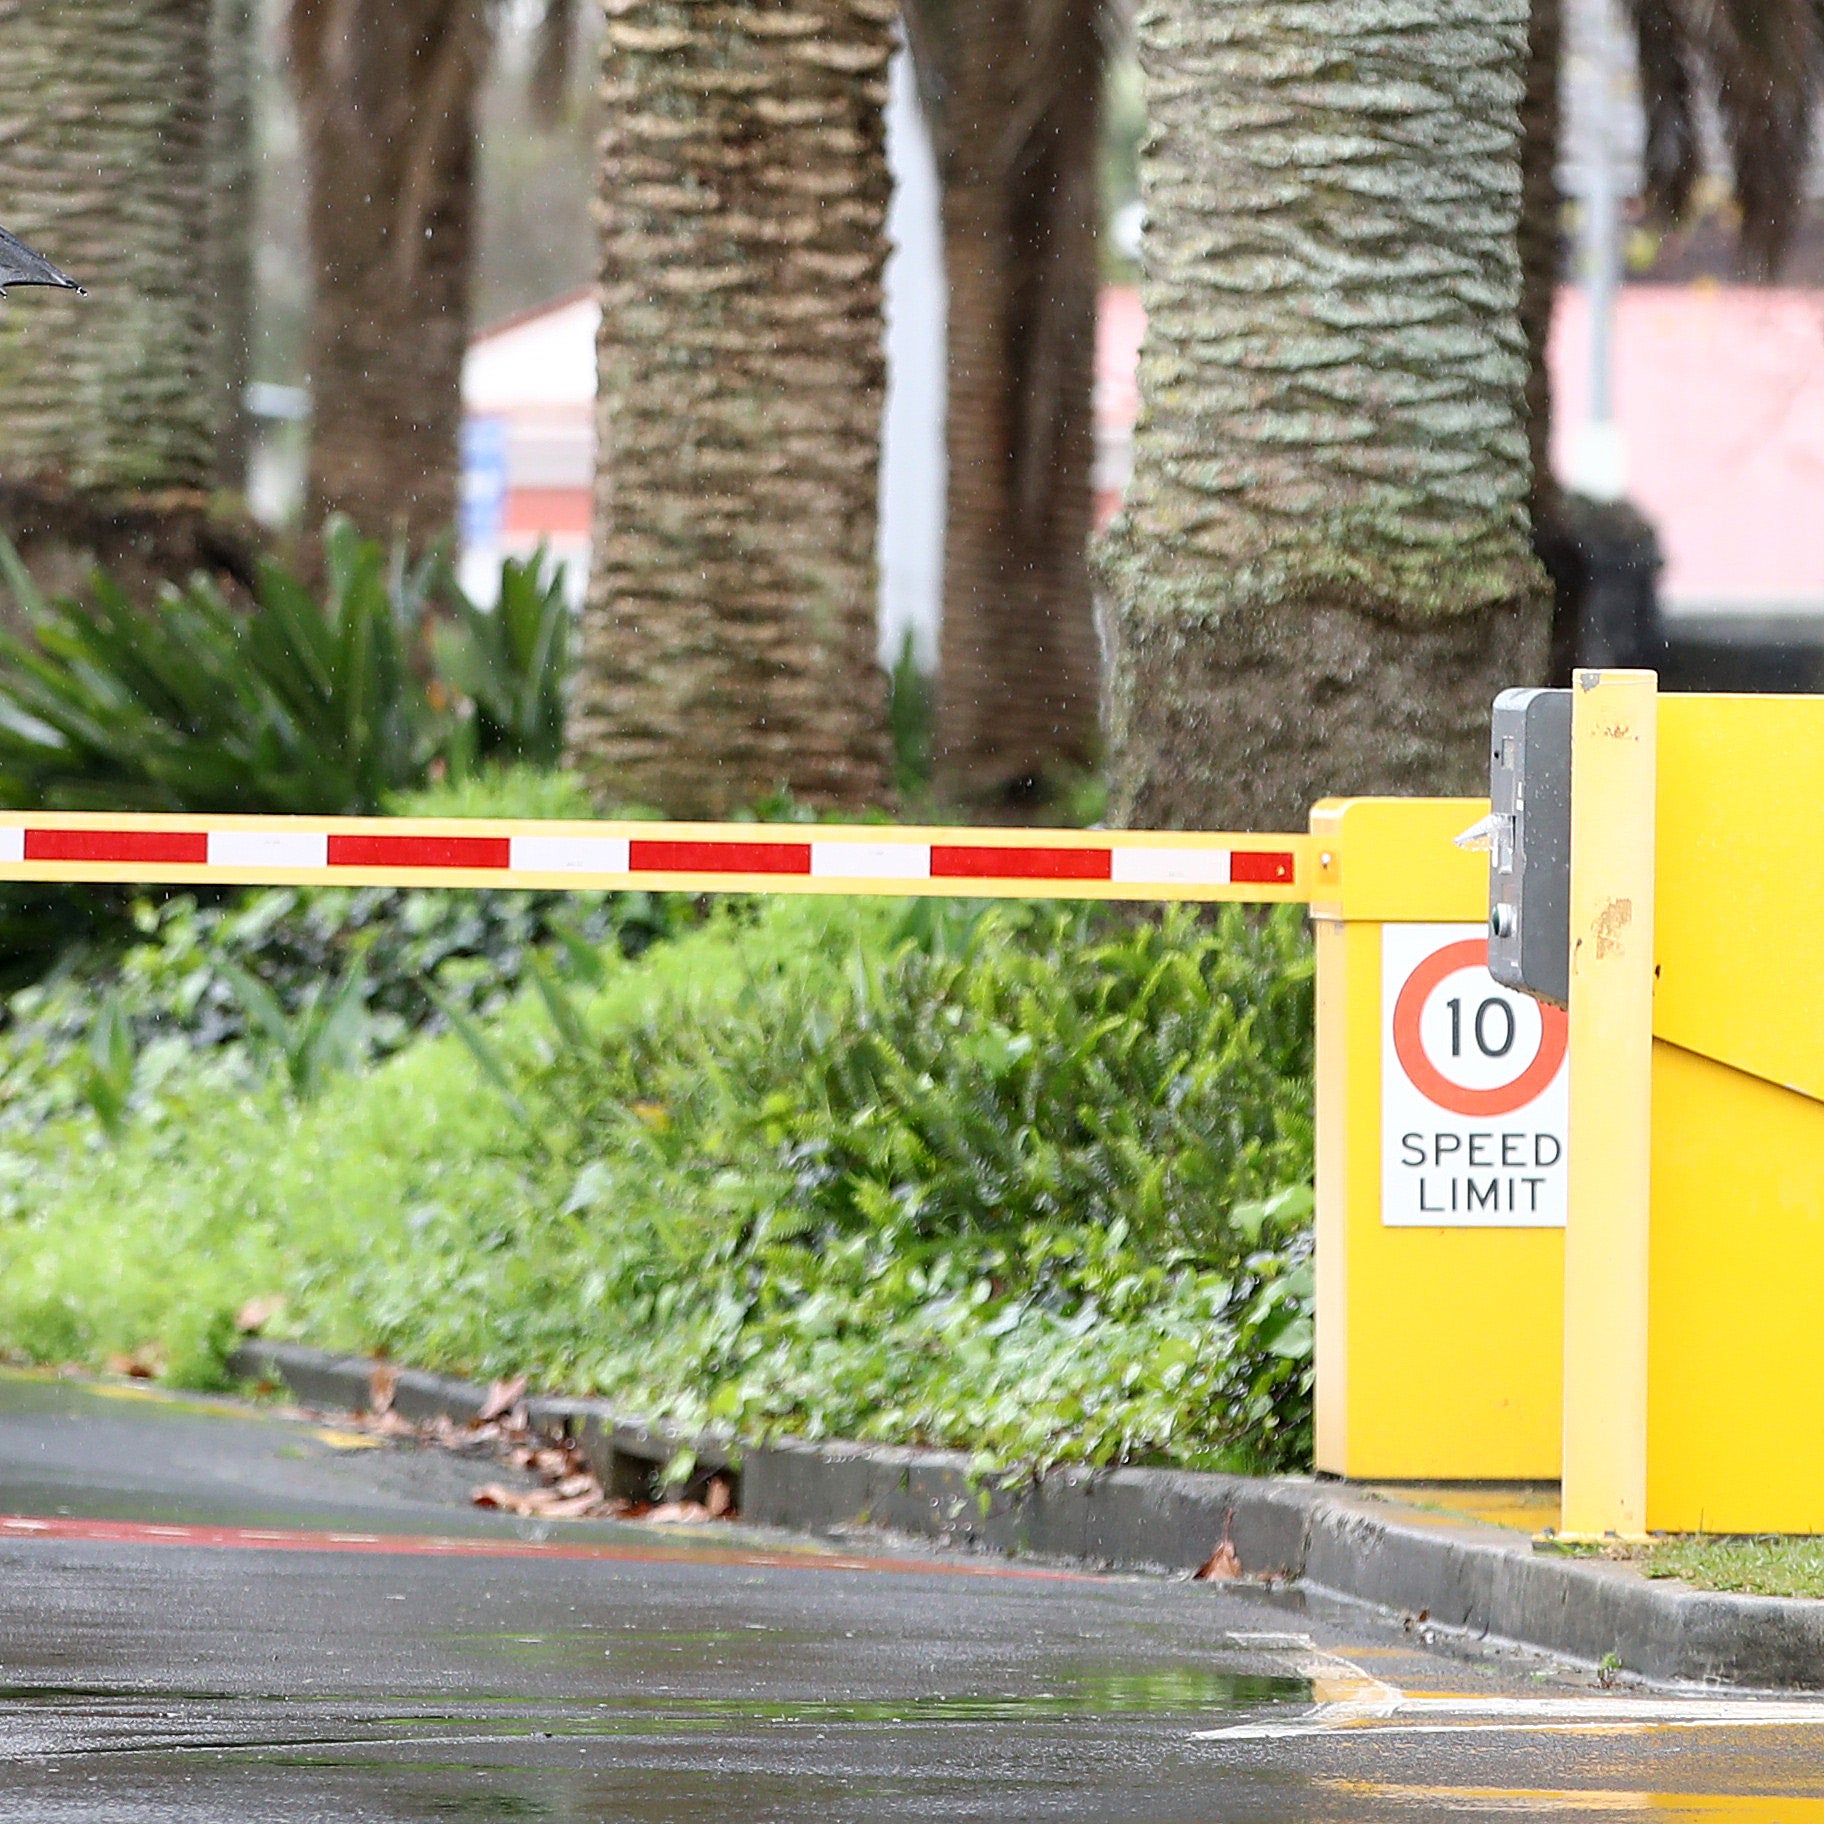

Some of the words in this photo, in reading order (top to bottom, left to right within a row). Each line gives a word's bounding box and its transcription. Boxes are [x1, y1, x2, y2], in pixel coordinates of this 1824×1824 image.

[1445, 997, 1516, 1057] 10
[1401, 1132, 1562, 1168] SPEED
[1419, 1178, 1546, 1213] LIMIT
